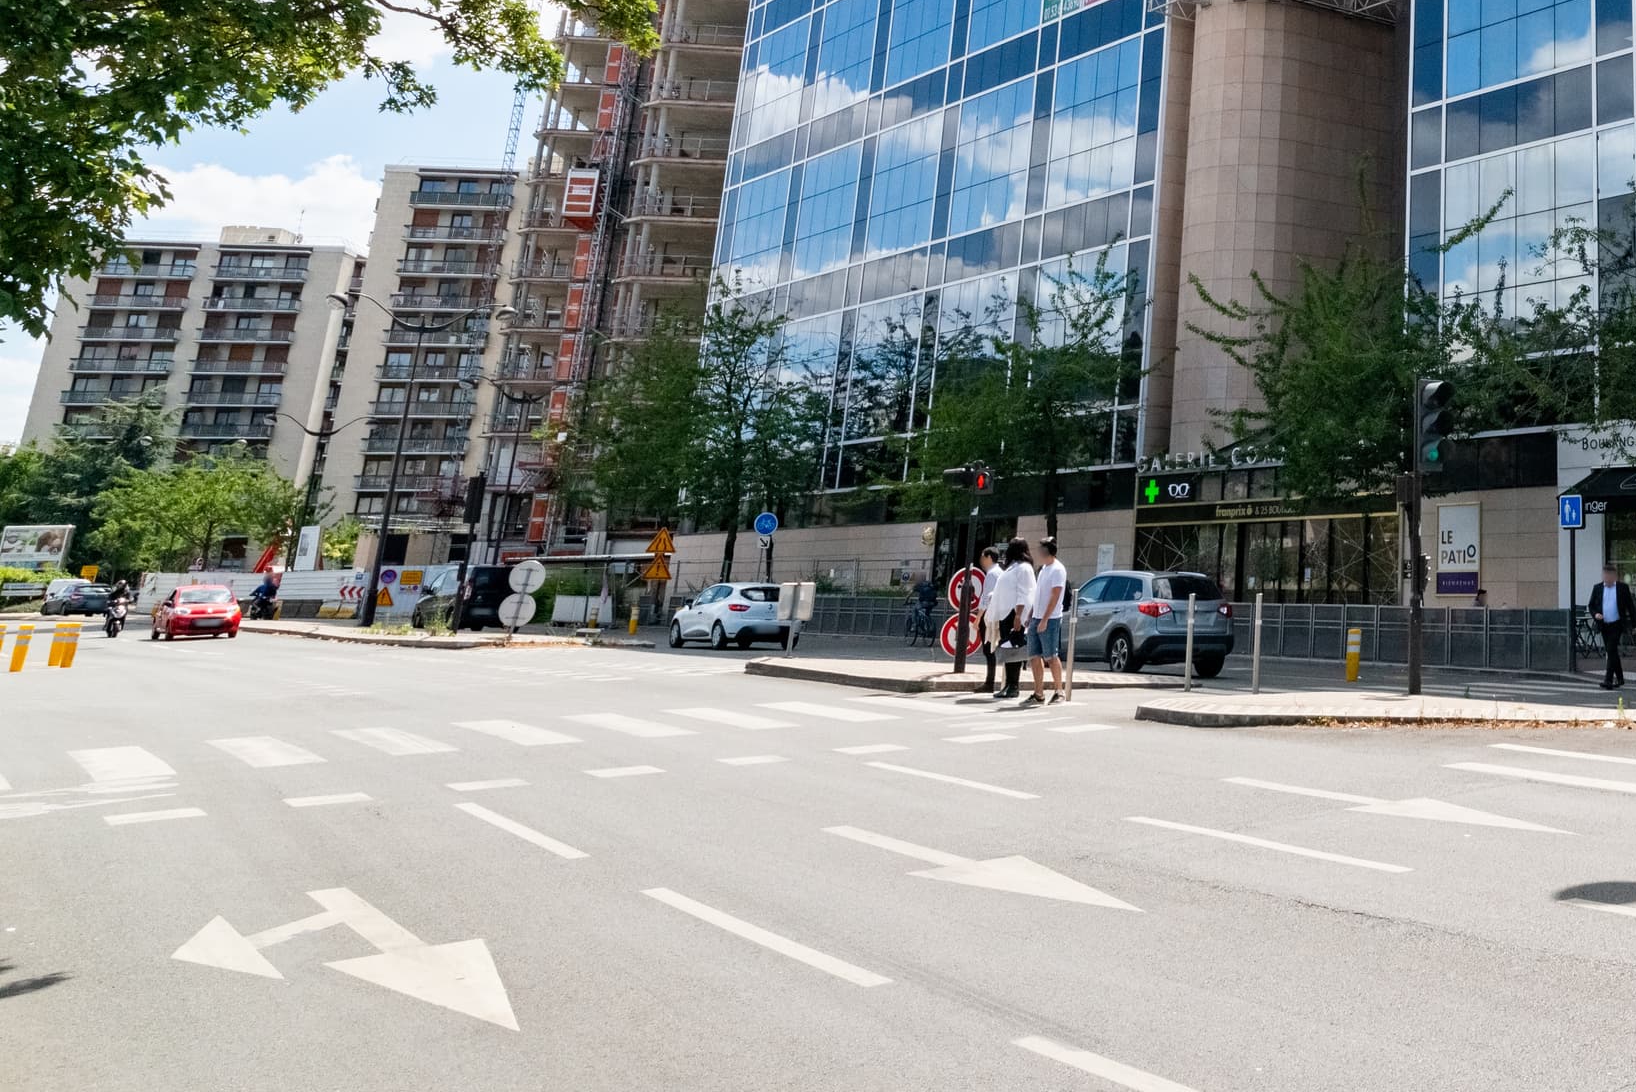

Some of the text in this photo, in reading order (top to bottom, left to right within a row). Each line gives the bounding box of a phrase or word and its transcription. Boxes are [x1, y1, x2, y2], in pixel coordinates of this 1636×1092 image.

[1136, 452, 1217, 473] GALERIE
[1216, 505, 1246, 518] franprix
[1441, 530, 1453, 544] LE
[1441, 544, 1476, 564] PATIO
